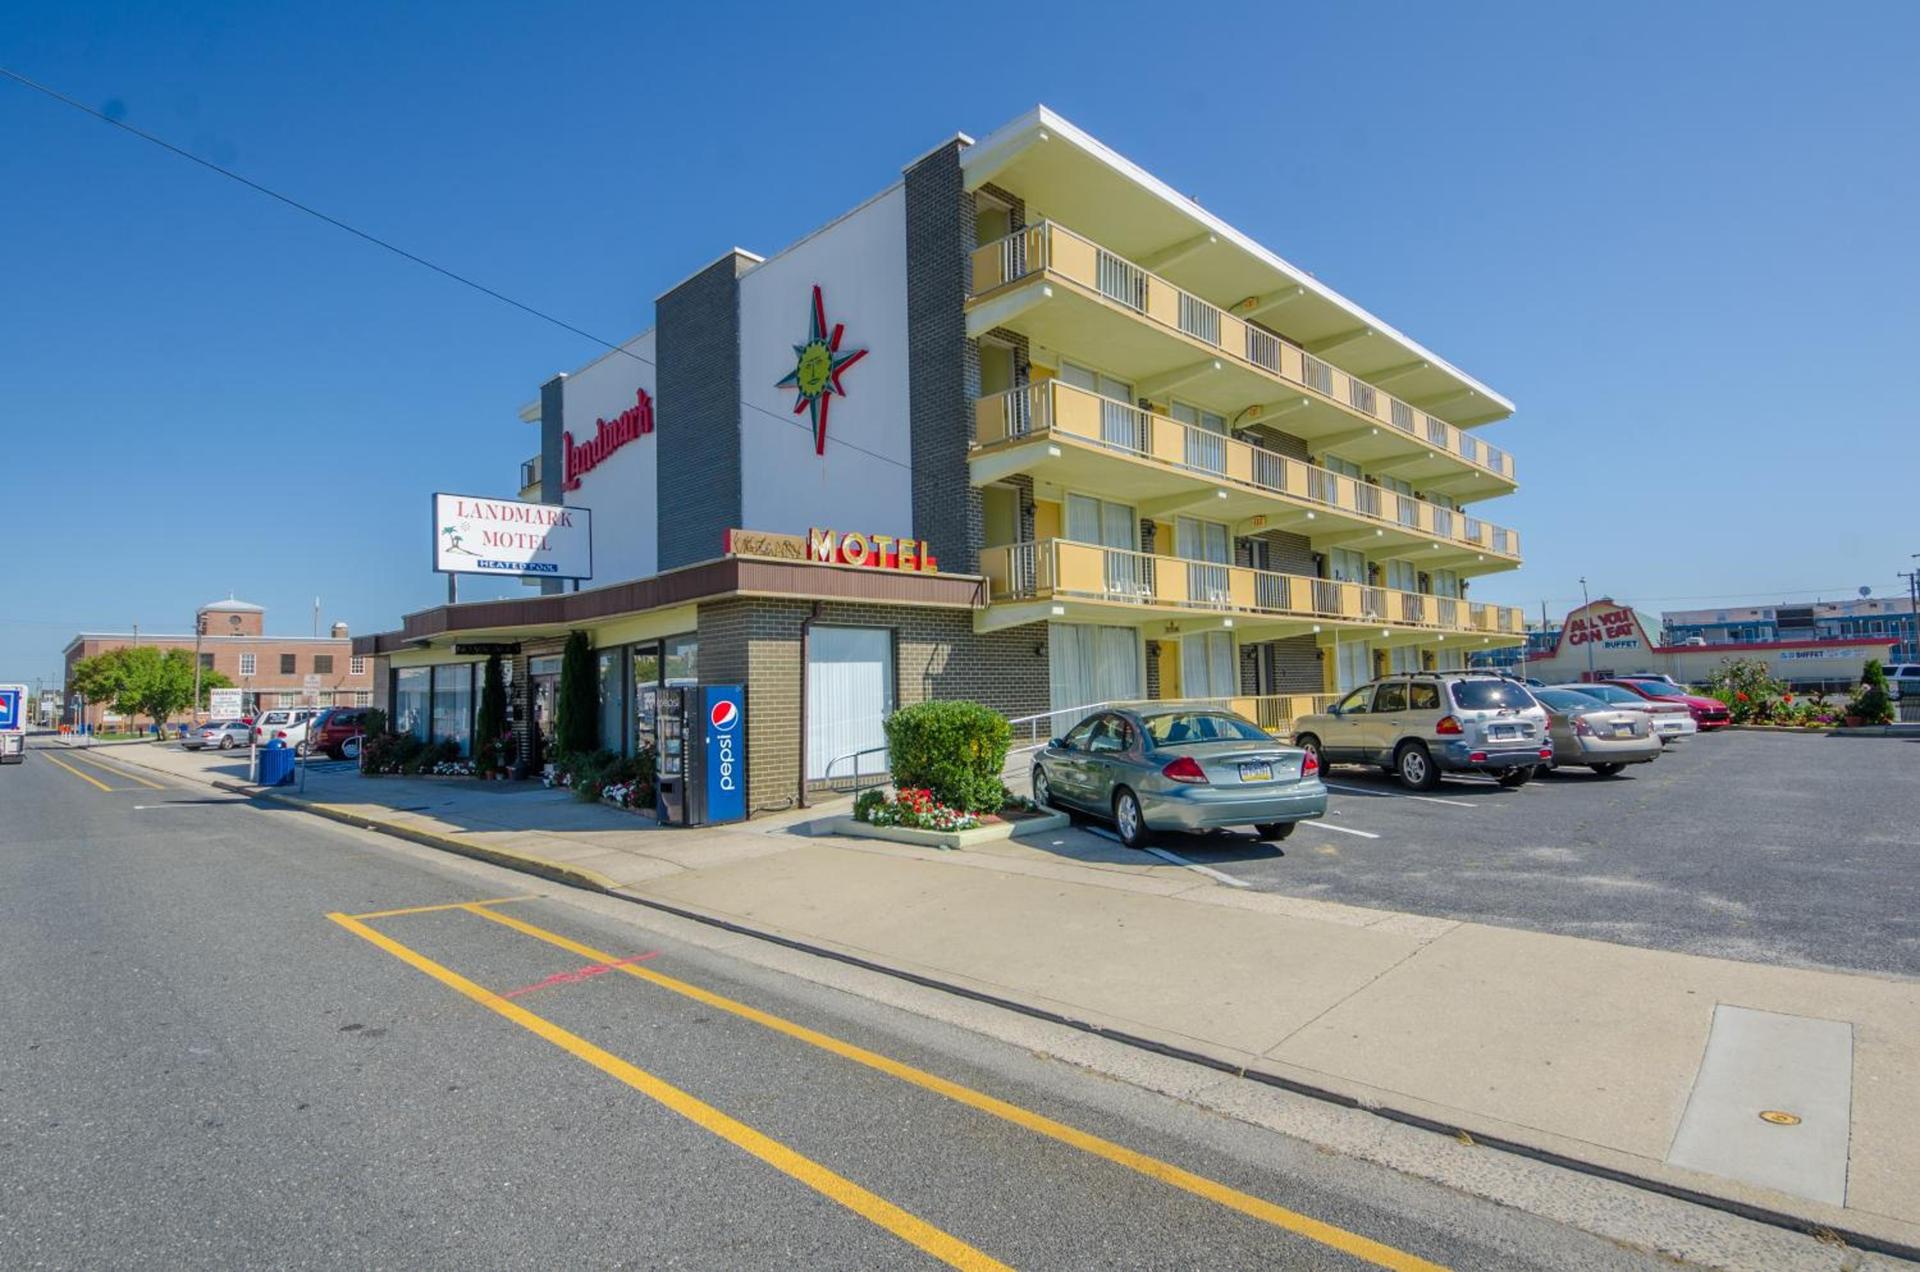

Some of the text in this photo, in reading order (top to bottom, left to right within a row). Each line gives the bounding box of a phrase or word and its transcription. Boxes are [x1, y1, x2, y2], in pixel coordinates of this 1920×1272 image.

[562, 387, 654, 492] Landmark
[457, 501, 573, 528] LANDMARK
[482, 530, 552, 551] MOTEL
[809, 527, 938, 574] MOTEL
[480, 560, 555, 572] HEATED POOL
[1570, 608, 1630, 633] ALL YOU
[1569, 622, 1634, 645] CAN EAT
[1604, 640, 1637, 649] BUFFET
[717, 734, 735, 791] pepsi
